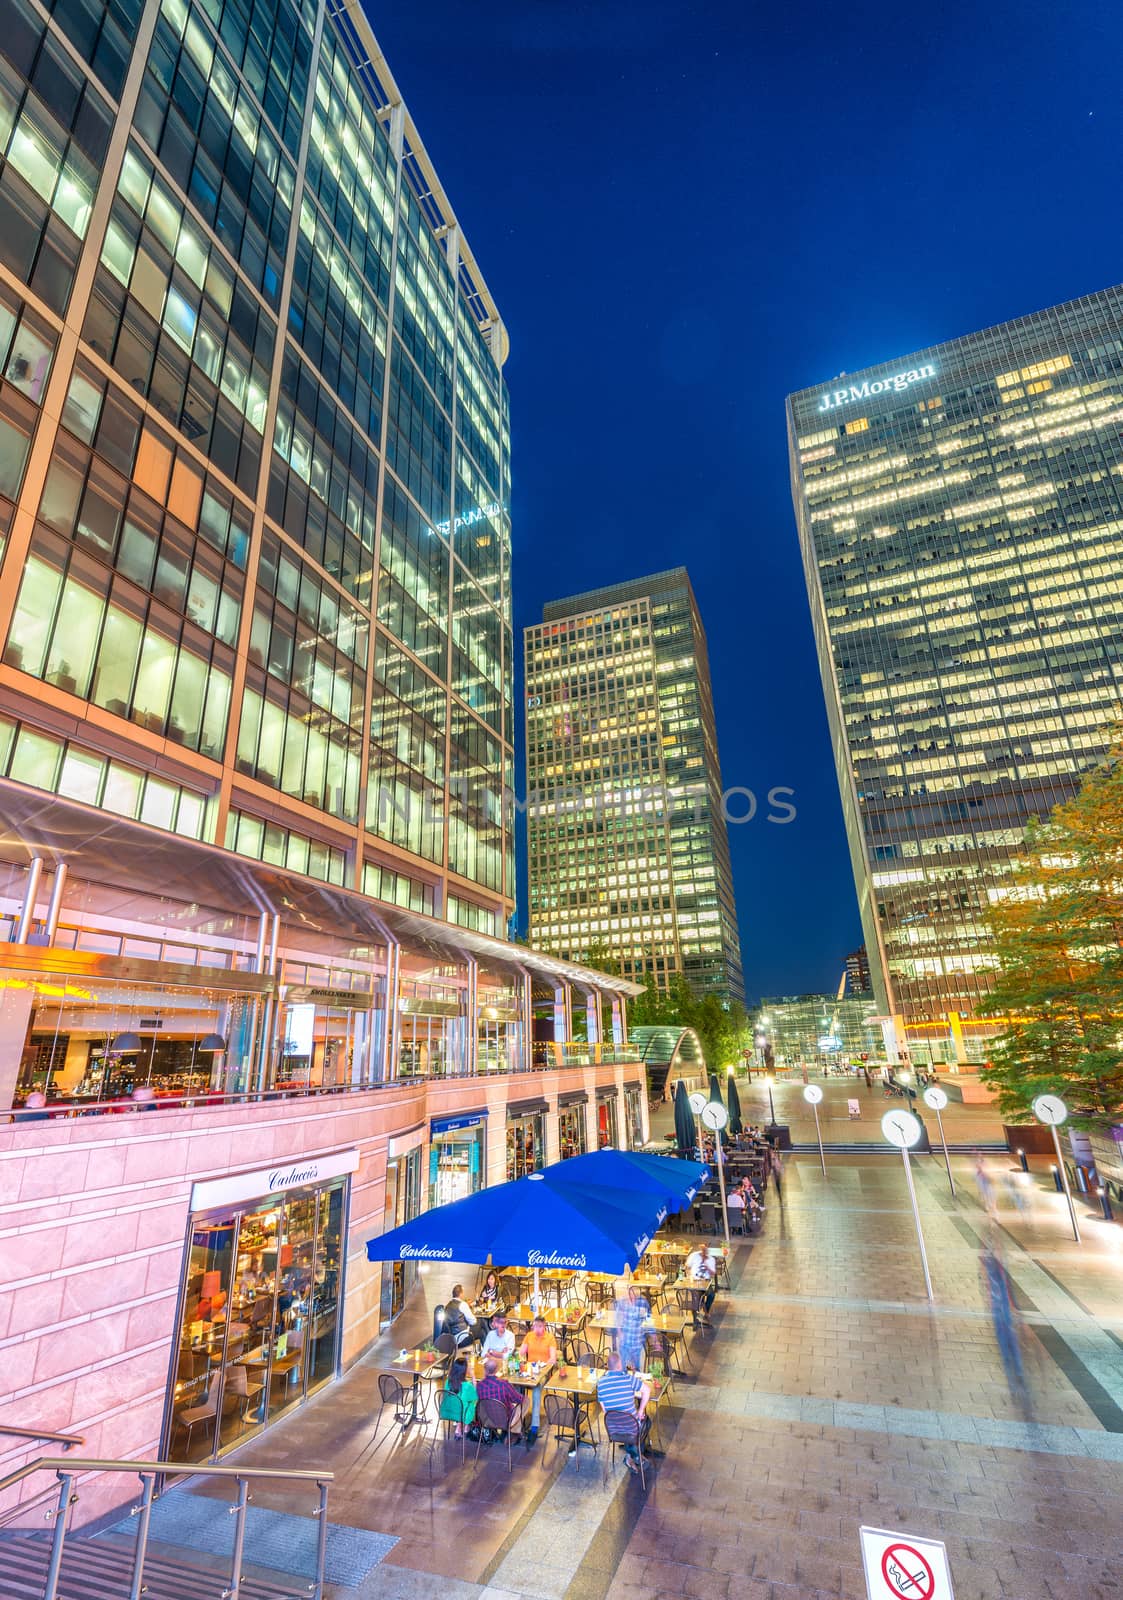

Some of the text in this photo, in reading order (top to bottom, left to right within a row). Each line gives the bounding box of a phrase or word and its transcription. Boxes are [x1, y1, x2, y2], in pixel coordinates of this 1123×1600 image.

[818, 364, 936, 412] J.P.Morgan
[268, 1165, 319, 1191] Carluccio's
[399, 1243, 453, 1259] Carluccio's
[527, 1249, 587, 1267] Carluccio's
